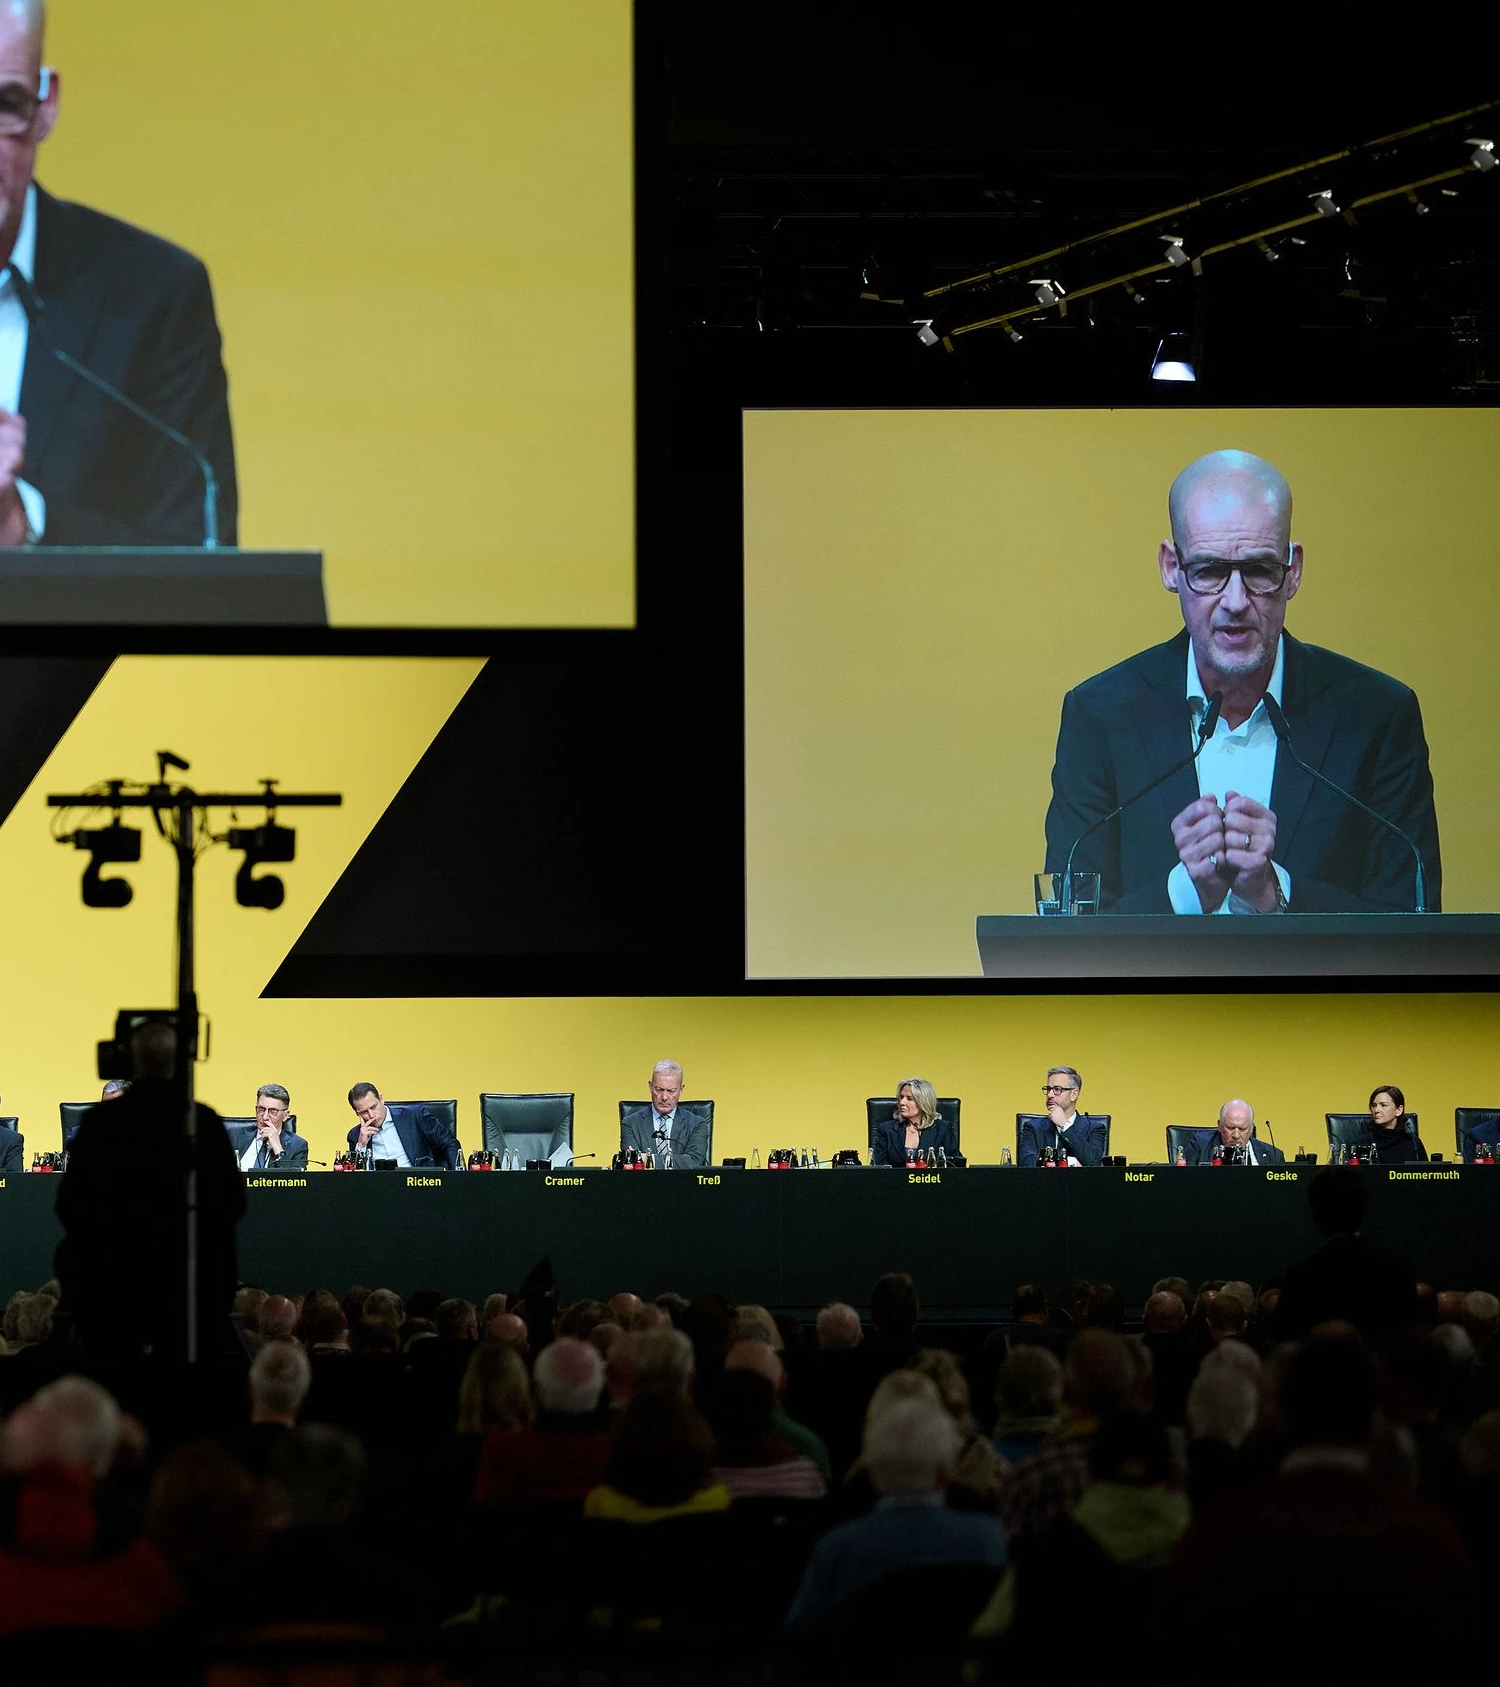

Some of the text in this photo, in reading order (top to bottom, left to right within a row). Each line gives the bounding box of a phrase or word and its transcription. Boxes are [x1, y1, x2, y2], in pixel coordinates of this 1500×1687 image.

[696, 1174, 721, 1185] Treß
[908, 1173, 942, 1184] Seidel
[1124, 1171, 1155, 1182] Notar
[1266, 1170, 1298, 1181] Geske
[1388, 1169, 1460, 1180] Dommermuth
[246, 1177, 307, 1188] Leitermann
[406, 1176, 442, 1187] Ricken
[545, 1175, 585, 1186] Cramer
